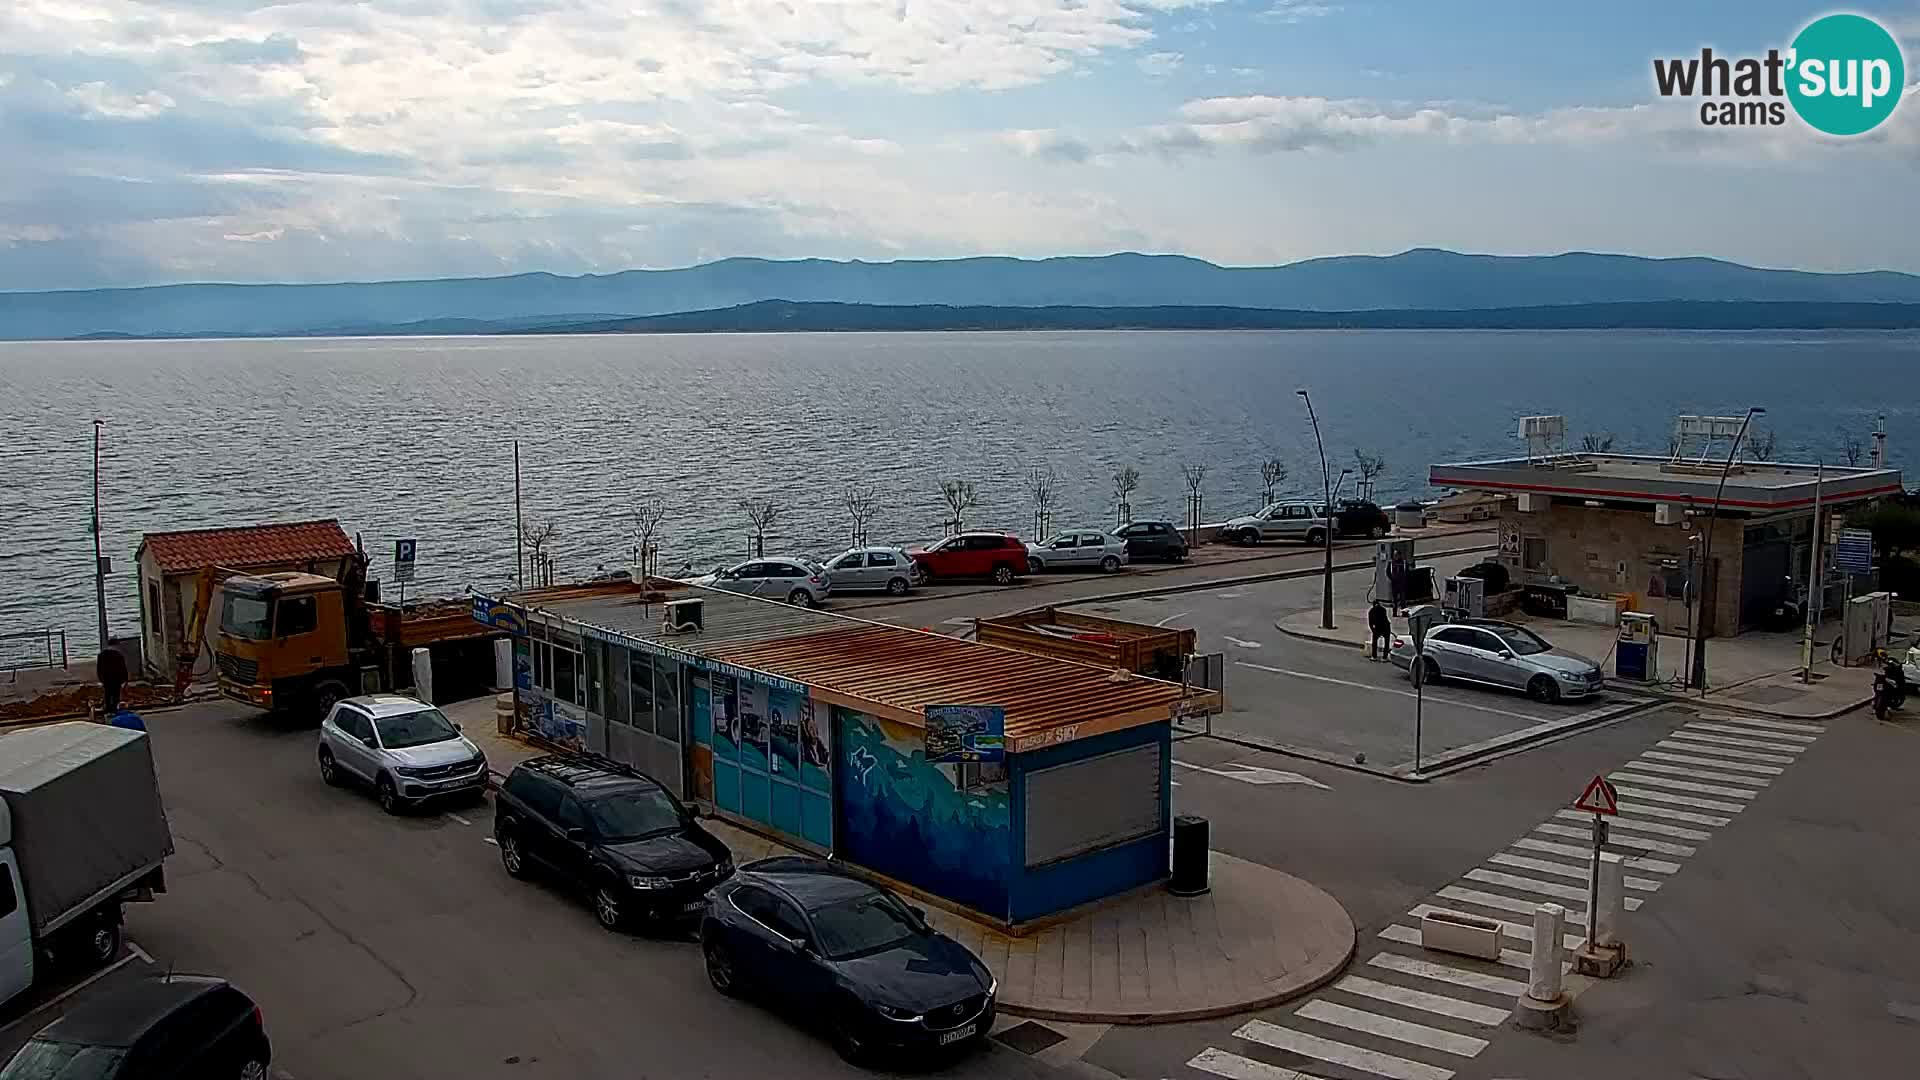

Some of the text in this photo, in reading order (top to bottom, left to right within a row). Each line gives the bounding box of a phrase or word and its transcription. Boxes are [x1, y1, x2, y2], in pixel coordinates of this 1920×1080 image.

[400, 542, 411, 560] P
[667, 648, 696, 665] POSTAJA
[706, 660, 720, 670] BUS
[721, 664, 751, 680] STATION
[753, 672, 778, 687] TICKET
[779, 679, 805, 694] OFFICE
